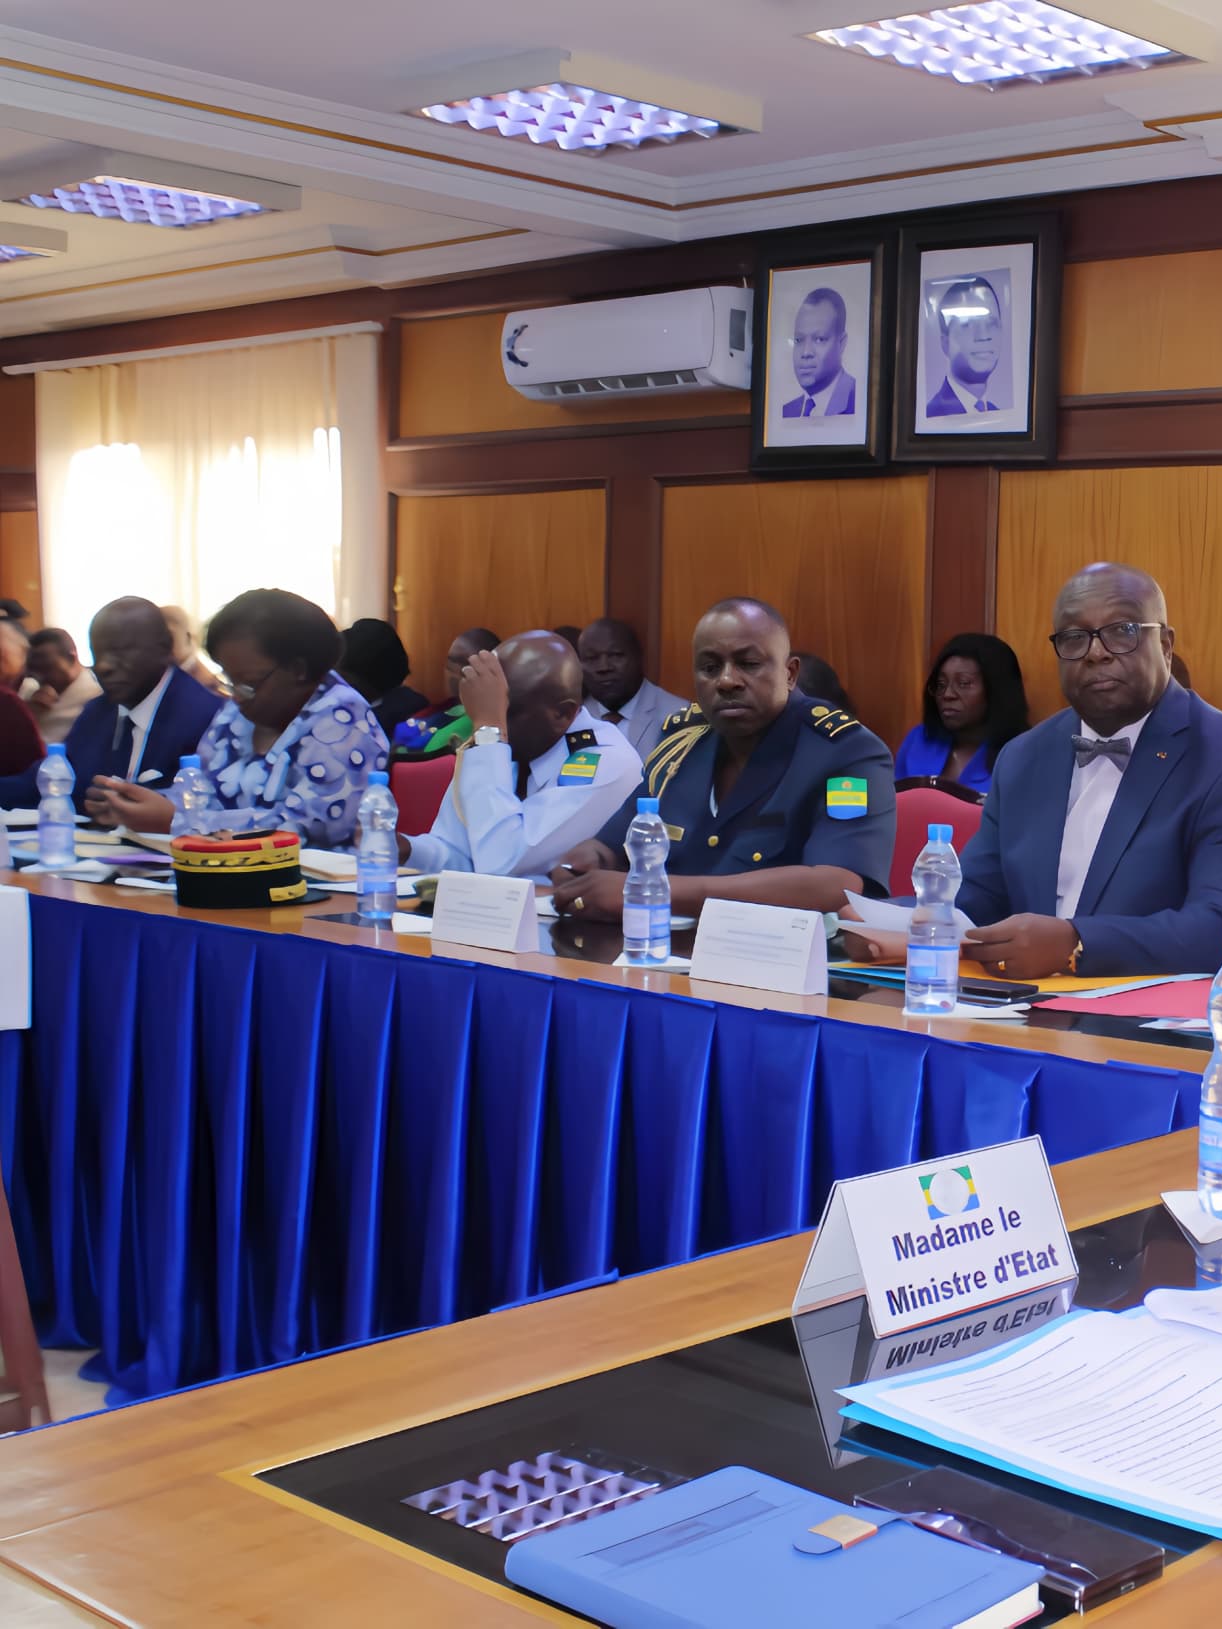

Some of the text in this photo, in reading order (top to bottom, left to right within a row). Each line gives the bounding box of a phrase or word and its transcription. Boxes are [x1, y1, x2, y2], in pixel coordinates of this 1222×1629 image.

[892, 1206, 1022, 1262] Madame le
[885, 1243, 1059, 1316] Ministre d'Etat
